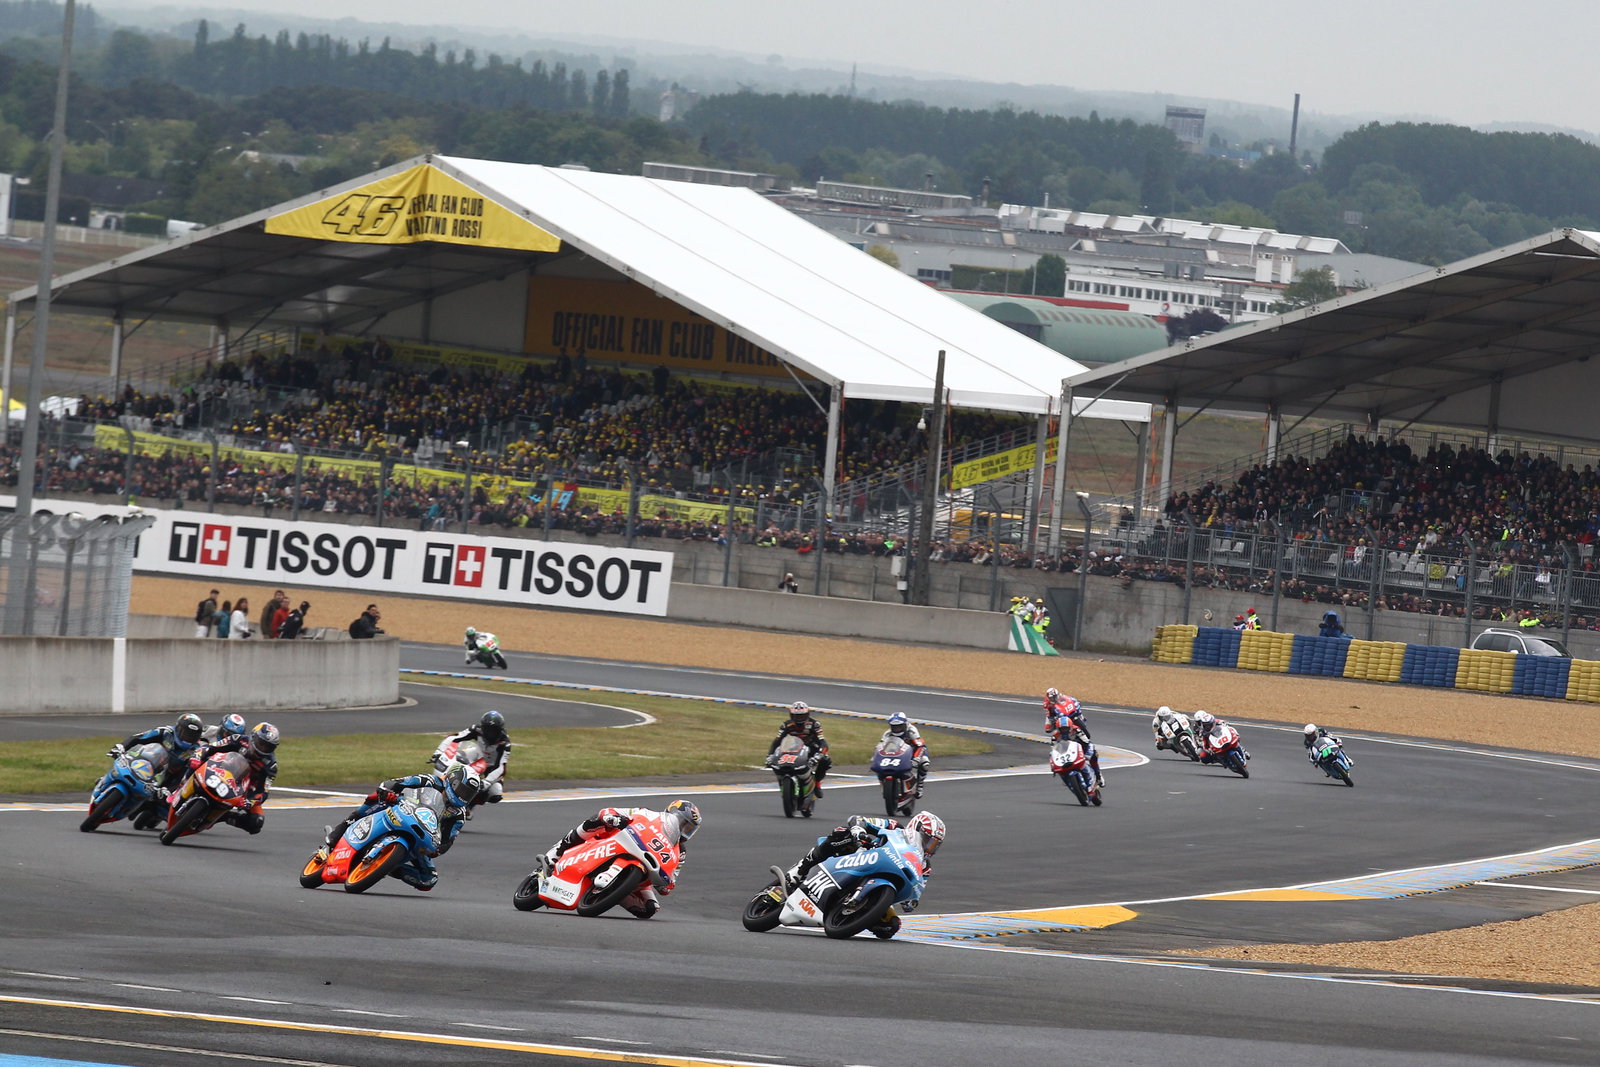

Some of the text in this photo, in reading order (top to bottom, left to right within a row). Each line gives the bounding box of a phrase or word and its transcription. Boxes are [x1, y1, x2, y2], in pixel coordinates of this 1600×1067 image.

[322, 193, 404, 236] 46
[441, 195, 458, 214] FAN
[460, 197, 484, 216] CLUB
[451, 218, 482, 239] ROSSI
[552, 311, 625, 353] OFFICIAL
[631, 317, 664, 356] FAN
[669, 321, 715, 361] CLUB
[236, 526, 407, 580] TISSOT
[491, 547, 663, 603] TISSOT
[879, 757, 902, 767] 84
[555, 841, 618, 876] MAPFRE
[646, 838, 671, 864] 94
[803, 870, 836, 900] JHK
[798, 898, 816, 918] KTM
